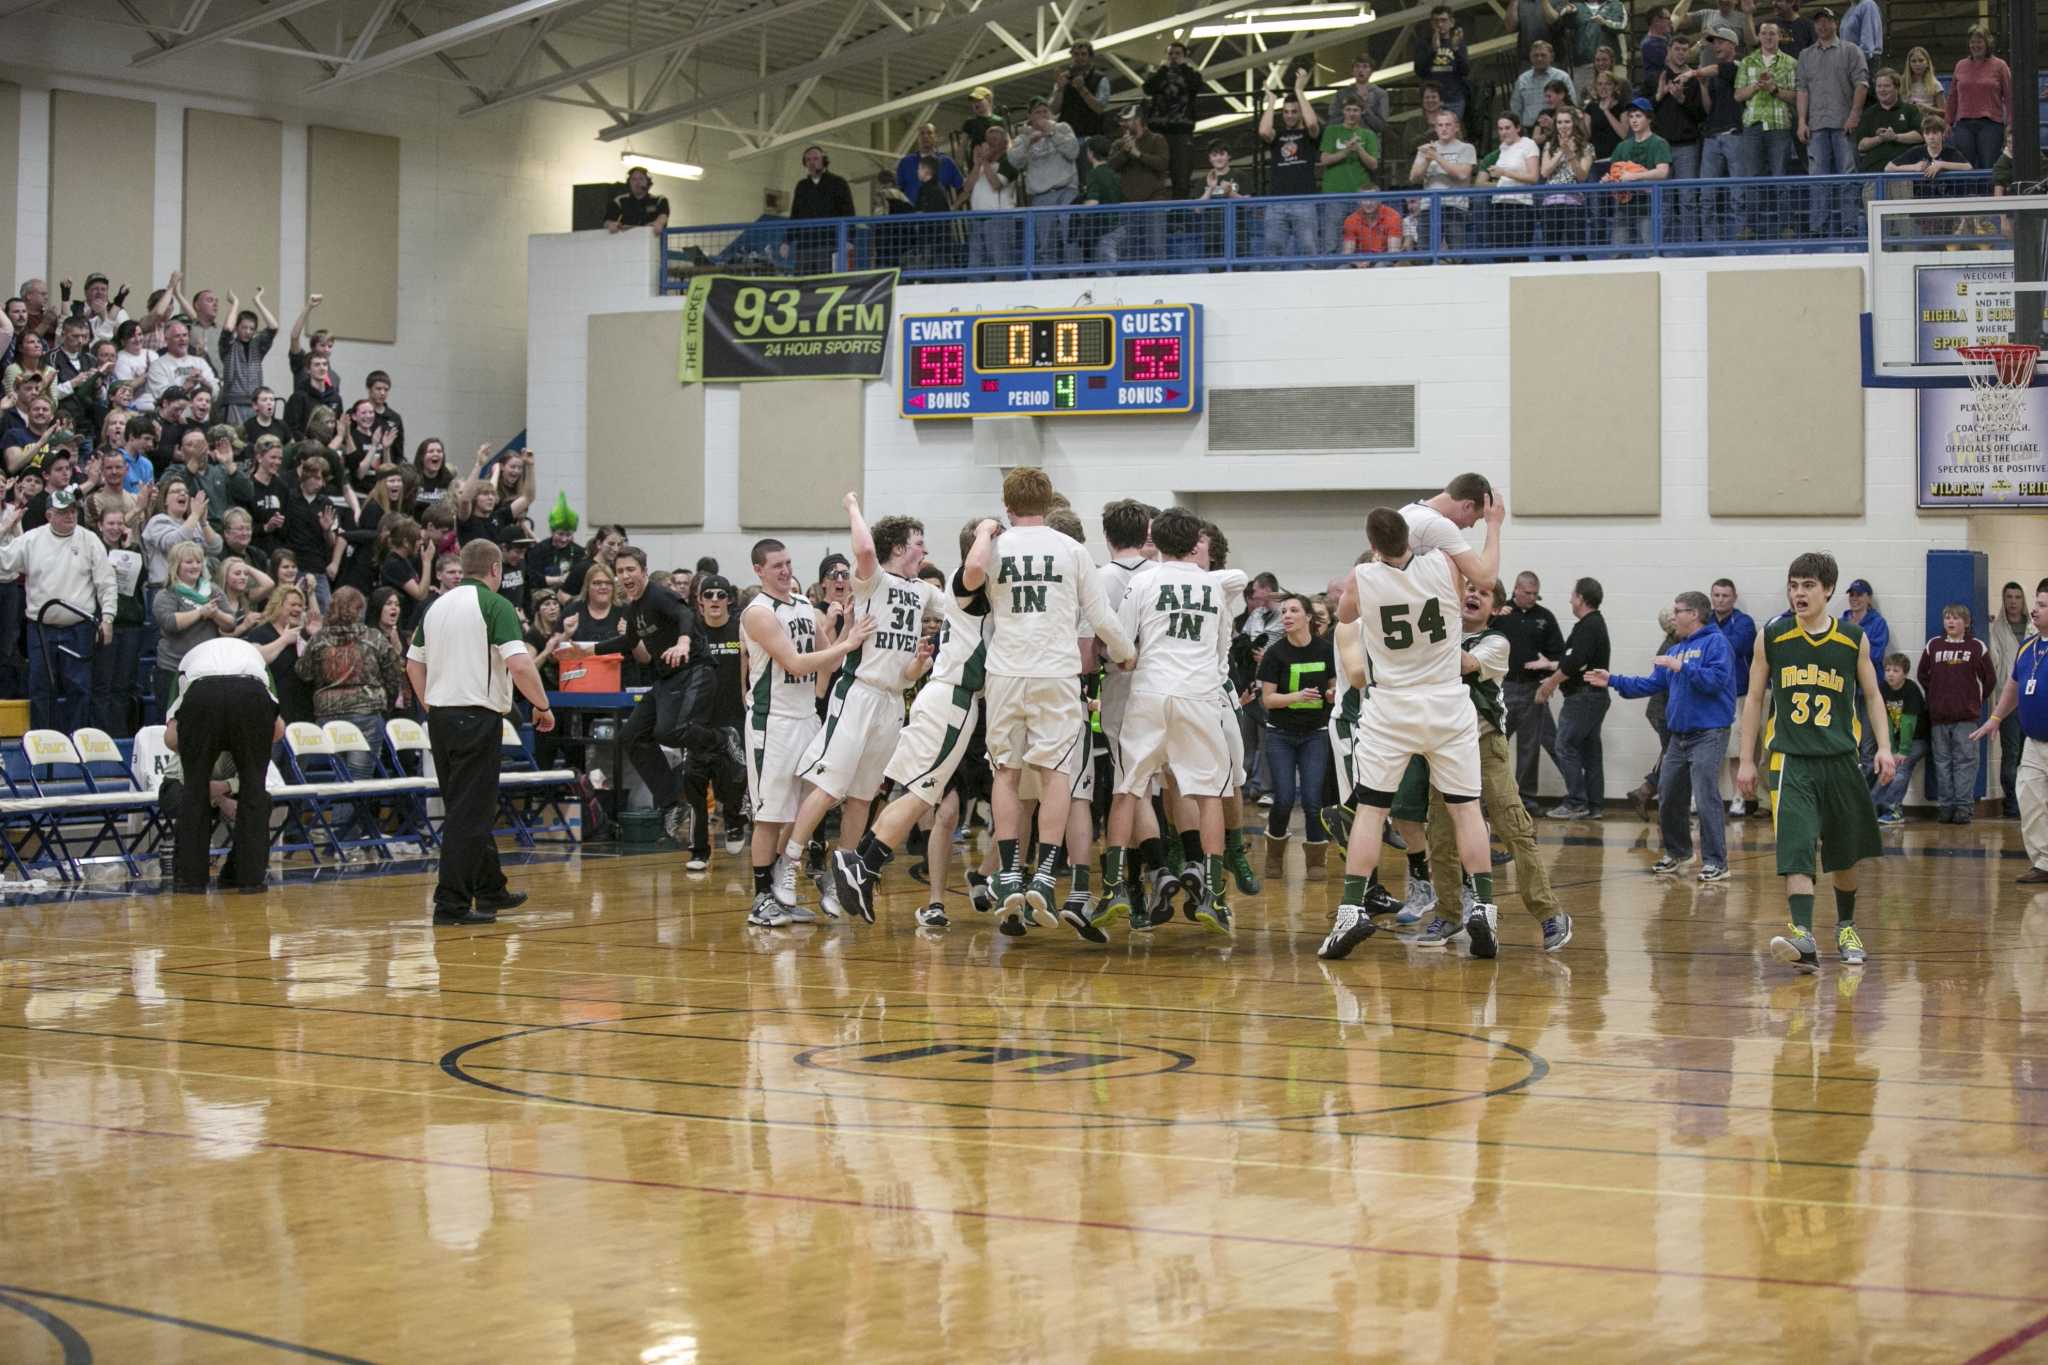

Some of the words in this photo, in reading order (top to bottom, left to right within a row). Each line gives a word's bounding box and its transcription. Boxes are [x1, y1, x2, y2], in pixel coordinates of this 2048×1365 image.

[1963, 271, 2006, 280] WELCOME
[687, 284, 704, 335] TICKET
[1923, 309, 1983, 322] HIGHLAD
[910, 320, 965, 341] EVART
[1122, 312, 1184, 333] GUEST
[1976, 325, 2008, 333] WHERE
[686, 341, 697, 370] THE
[764, 342, 781, 357] 24
[783, 341, 821, 356] HOUR
[824, 340, 882, 355] SPORTS
[1135, 337, 1180, 380] 52
[920, 345, 963, 386] 58
[928, 390, 970, 409] BONUS
[1008, 390, 1050, 406] PERIOD
[1056, 375, 1075, 408] 4
[1118, 387, 1163, 405] BONUS
[1945, 444, 1991, 453] OFFICIALS
[1993, 443, 2041, 453] OFFICIATE.
[1976, 434, 1991, 442] LET
[1994, 434, 2010, 442] THE
[1937, 465, 1990, 474] SPECTATORS
[1992, 465, 2004, 473] BE
[1976, 455, 1991, 463] LET
[1994, 455, 2010, 463] THE
[1929, 482, 1984, 496] WILDCAT
[2018, 481, 2048, 496] PRID
[998, 555, 1063, 584] ALL
[886, 587, 921, 610] PINE
[1011, 585, 1047, 613] IN
[1155, 584, 1218, 614] ALL
[890, 606, 915, 632] 34
[1165, 612, 1204, 642] IN
[1379, 597, 1447, 650] 54
[1791, 692, 1832, 727] 32
